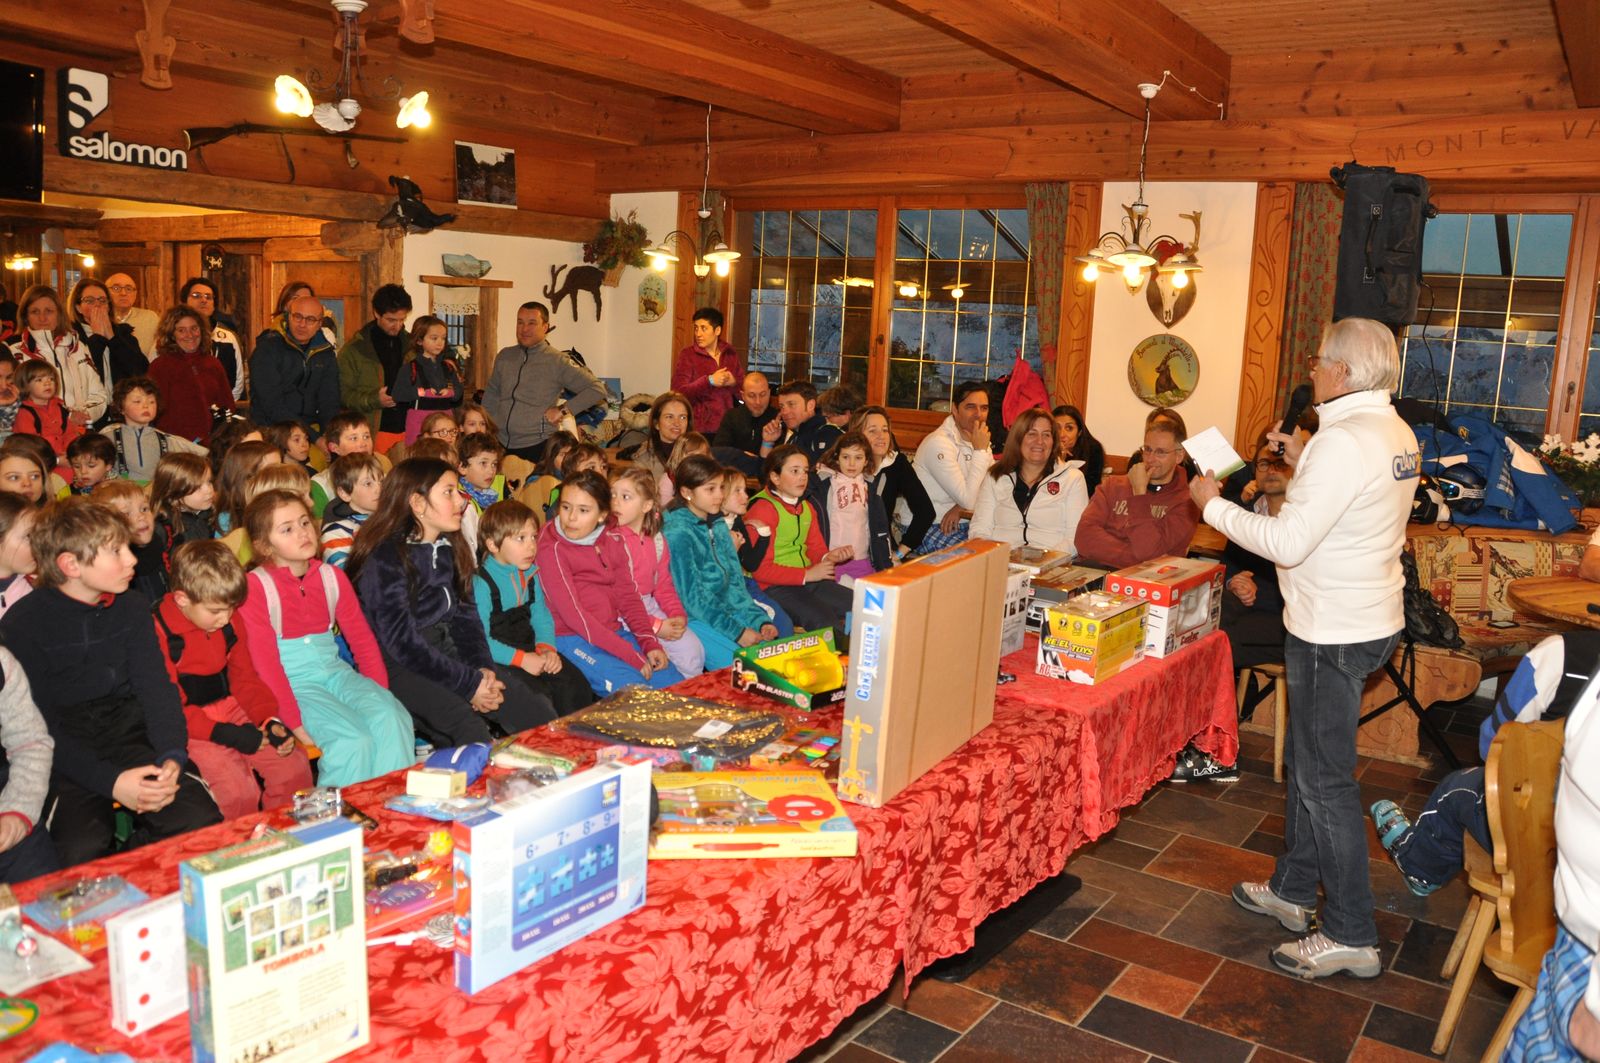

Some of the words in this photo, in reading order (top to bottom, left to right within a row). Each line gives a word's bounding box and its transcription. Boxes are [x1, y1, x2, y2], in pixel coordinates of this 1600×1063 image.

[69, 132, 187, 169] salomon
[1384, 126, 1517, 164] MONTE
[573, 648, 597, 666] GORE-TEX
[758, 635, 818, 659] TRI-BLASTER
[1071, 643, 1094, 655] TOYS
[756, 682, 794, 699] TRI-BLASTER
[262, 943, 325, 974] TOMBOLA
